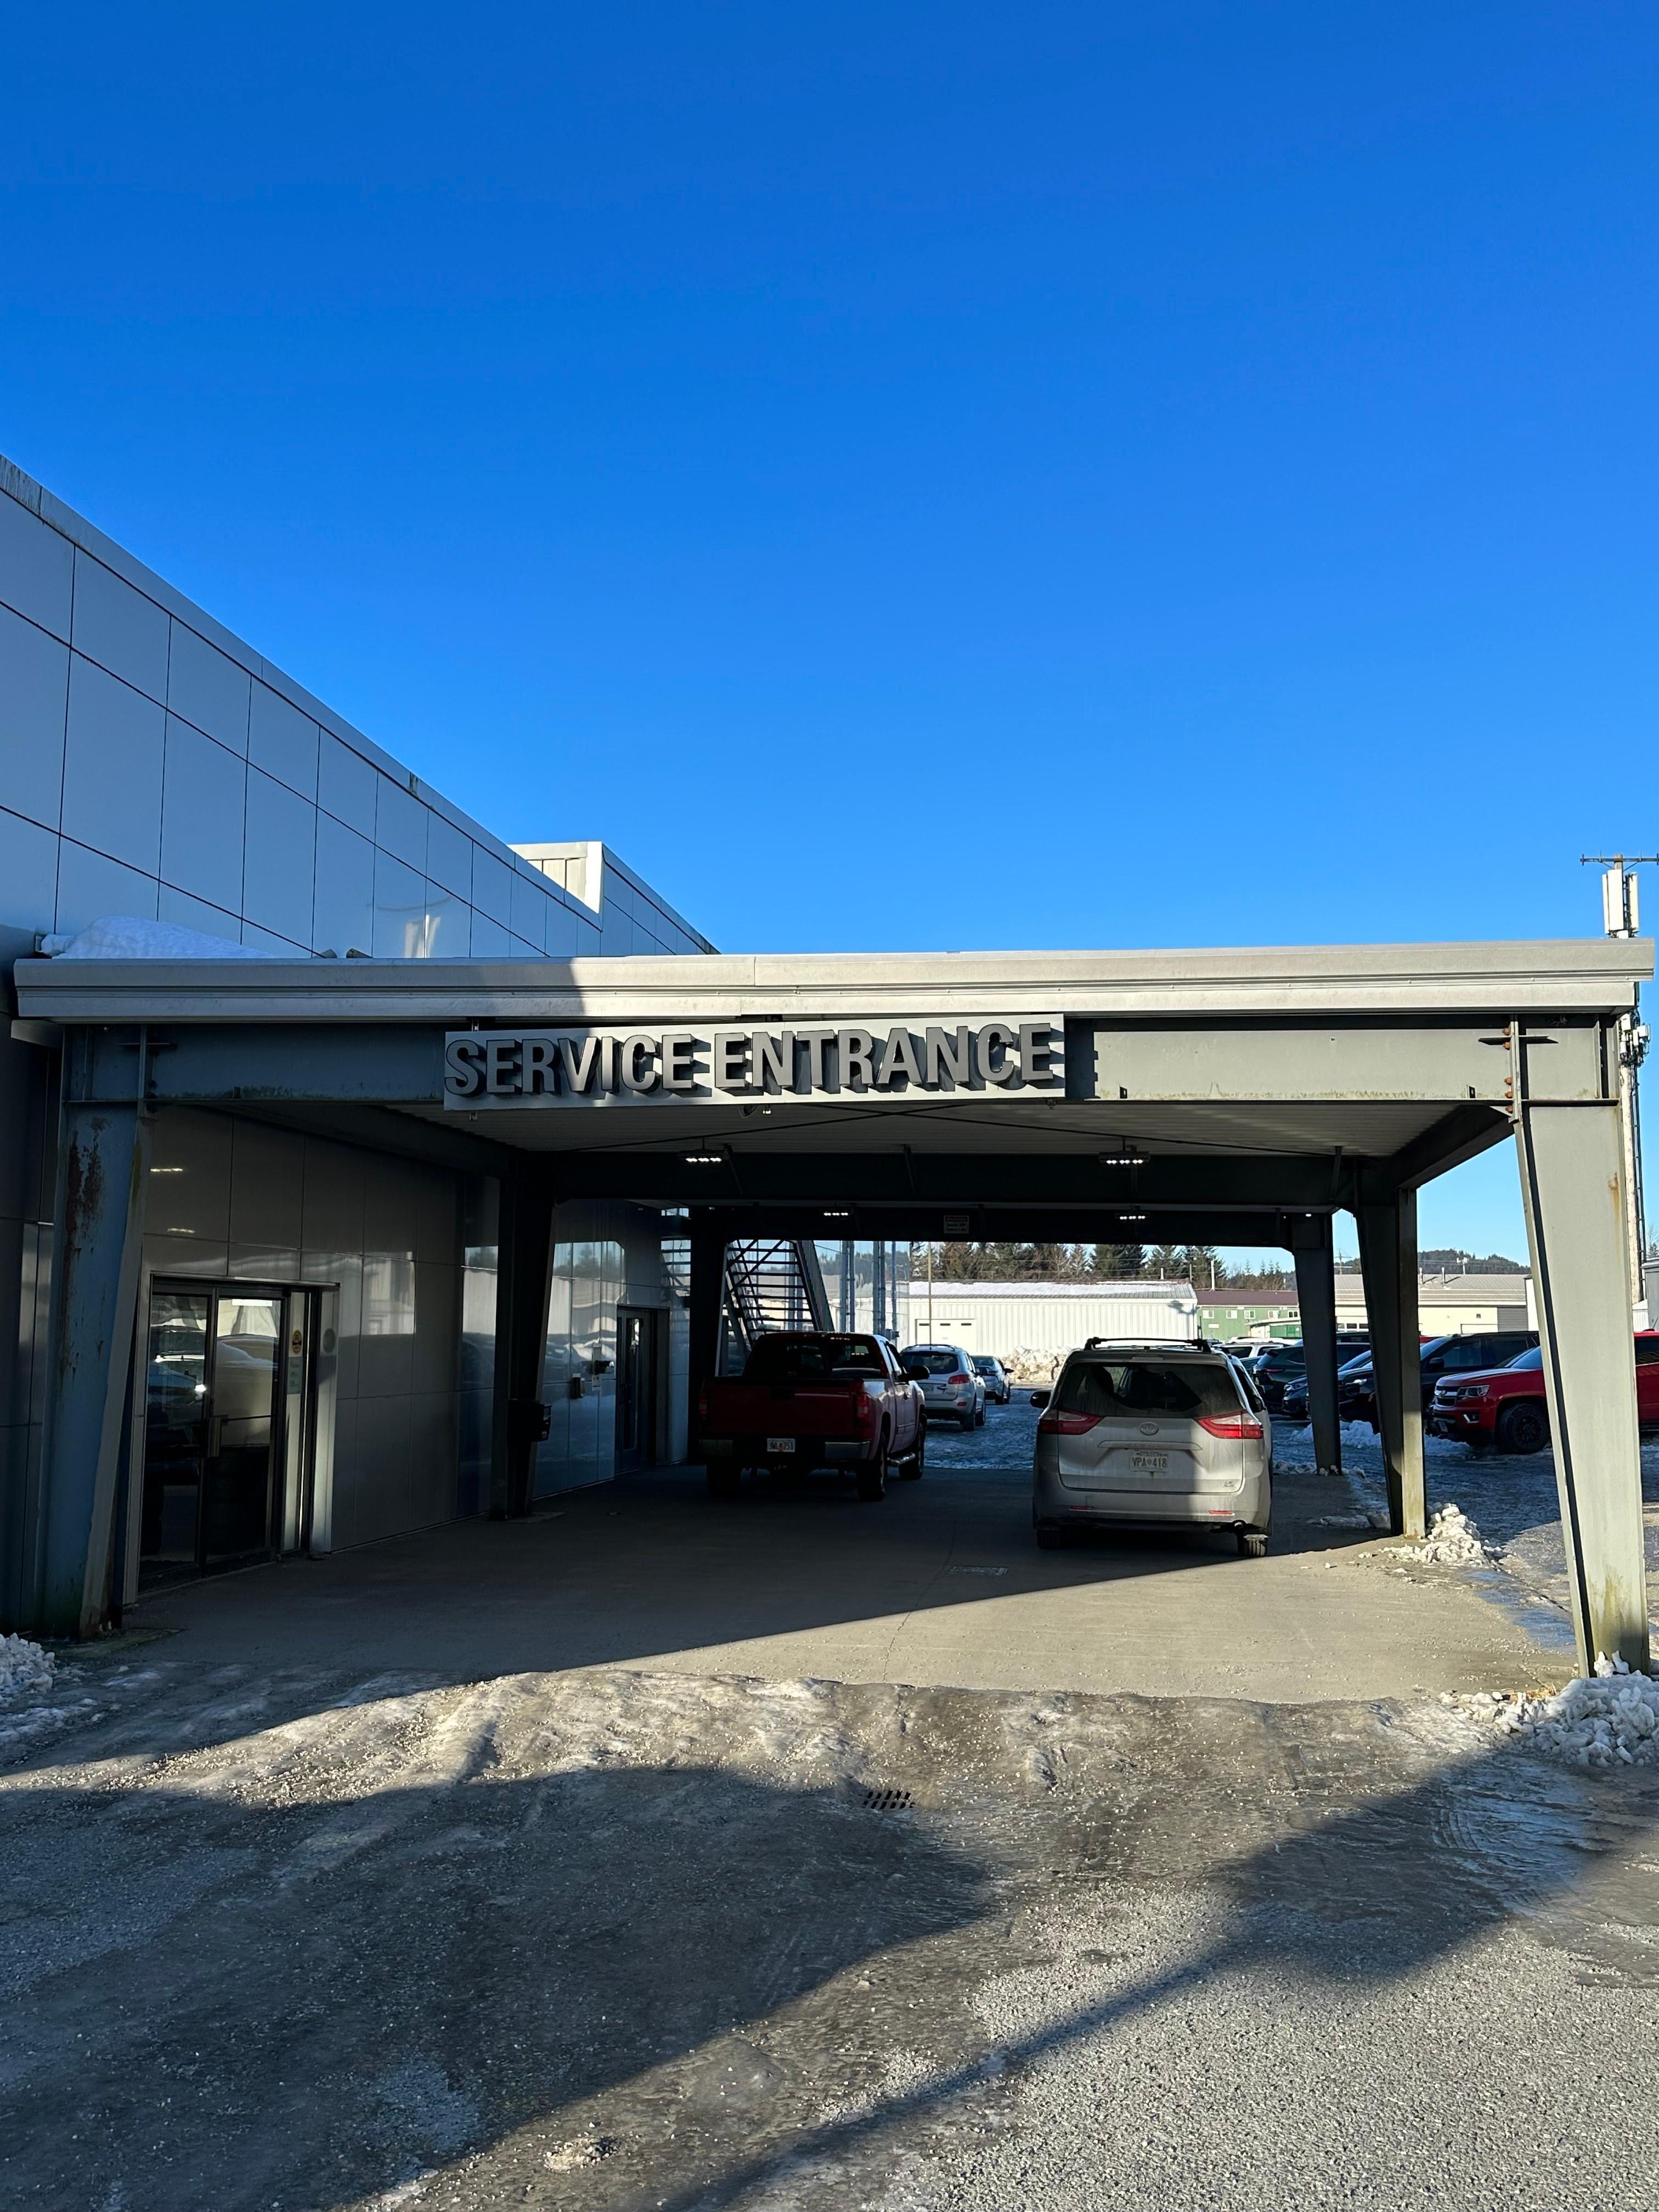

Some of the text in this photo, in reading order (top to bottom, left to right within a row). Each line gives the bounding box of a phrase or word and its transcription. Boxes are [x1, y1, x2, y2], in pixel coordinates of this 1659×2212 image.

[444, 1023, 1055, 1097] SERVICE ENTRANCE
[1132, 1457, 1167, 1468] VPA 418
